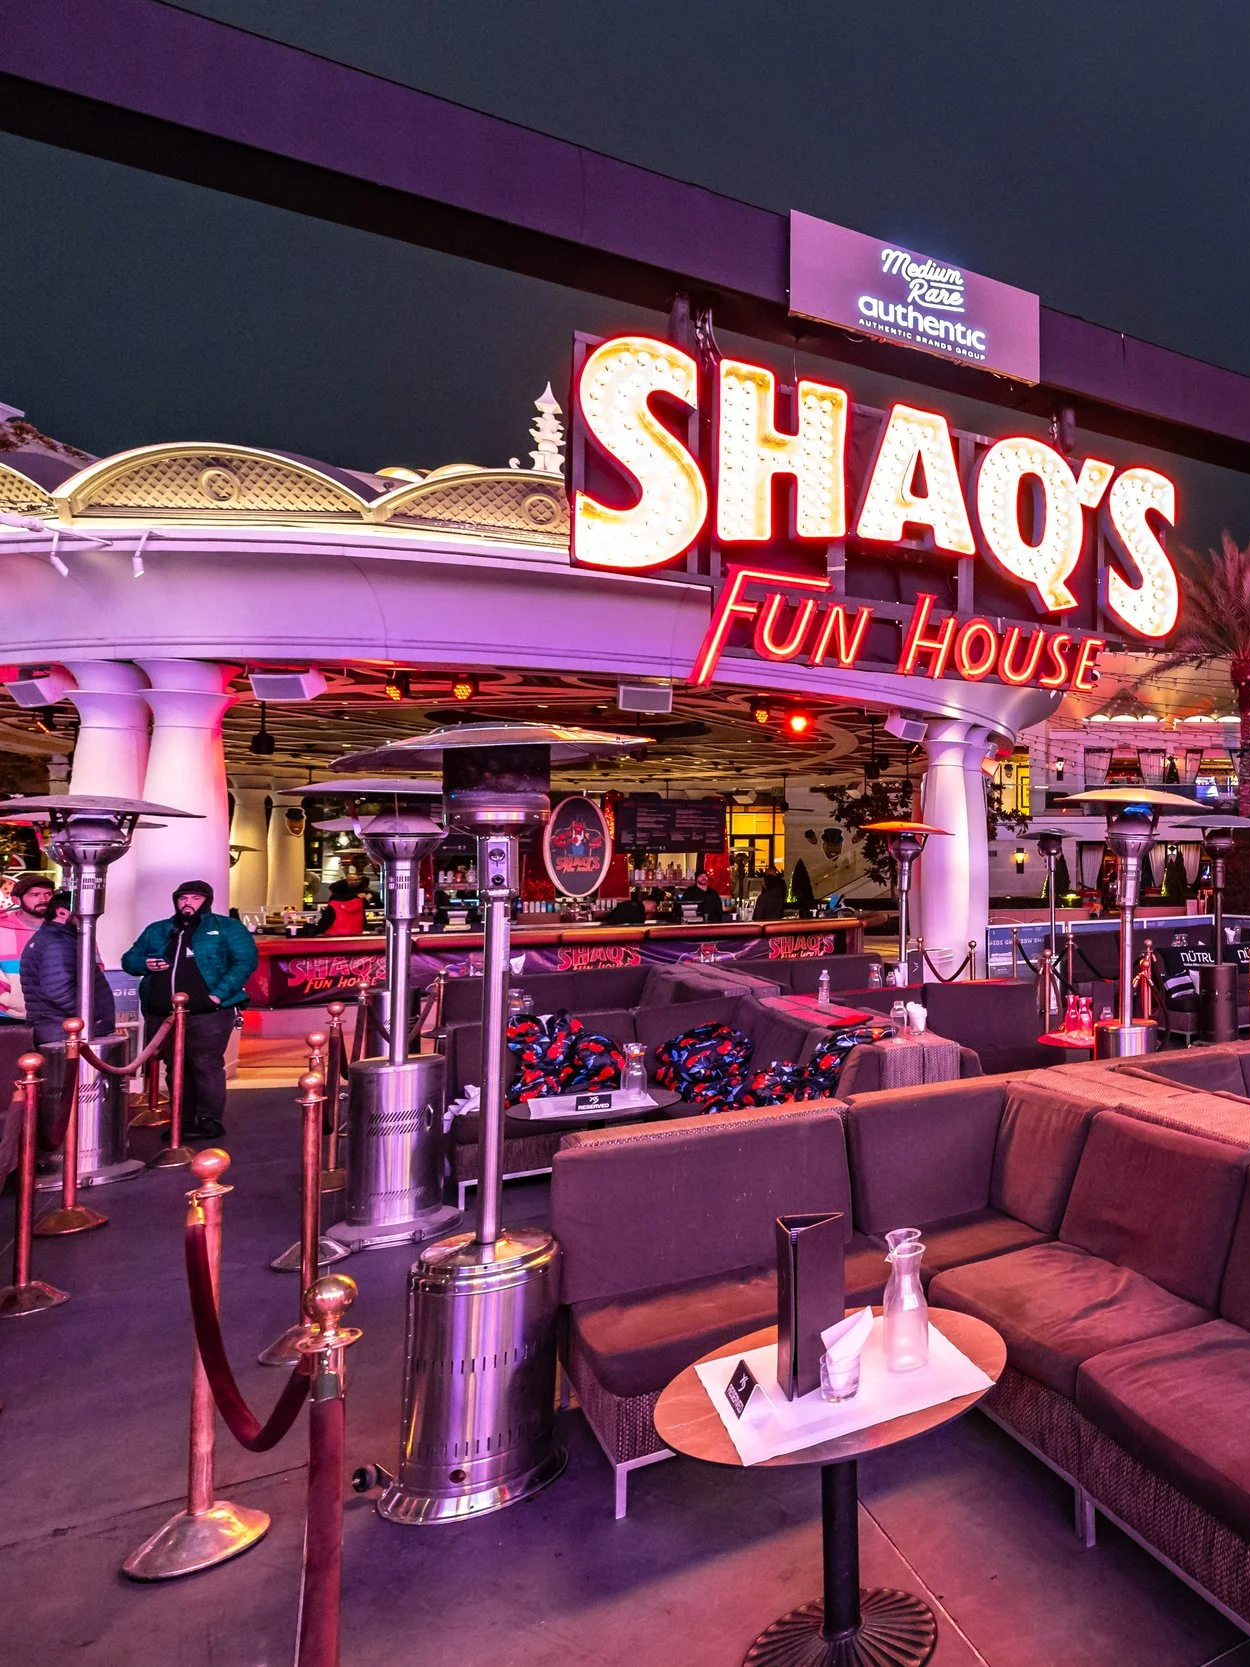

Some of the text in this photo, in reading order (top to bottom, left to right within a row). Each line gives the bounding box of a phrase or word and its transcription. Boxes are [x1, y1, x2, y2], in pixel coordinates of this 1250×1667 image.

[881, 248, 964, 285] Medium
[907, 279, 965, 311] Rare
[858, 295, 986, 351] authentic
[859, 318, 986, 361] AUTHENTIC BRANDS GROUP
[574, 335, 1180, 639] SHAQ'S
[685, 563, 1107, 692] FUN HOUSE
[558, 944, 641, 971] SHAQ'S
[769, 934, 835, 959] SHAQ'S
[304, 979, 333, 994] FUN
[578, 1102, 610, 1110] RESERVED
[727, 1383, 745, 1414] RESERVED
